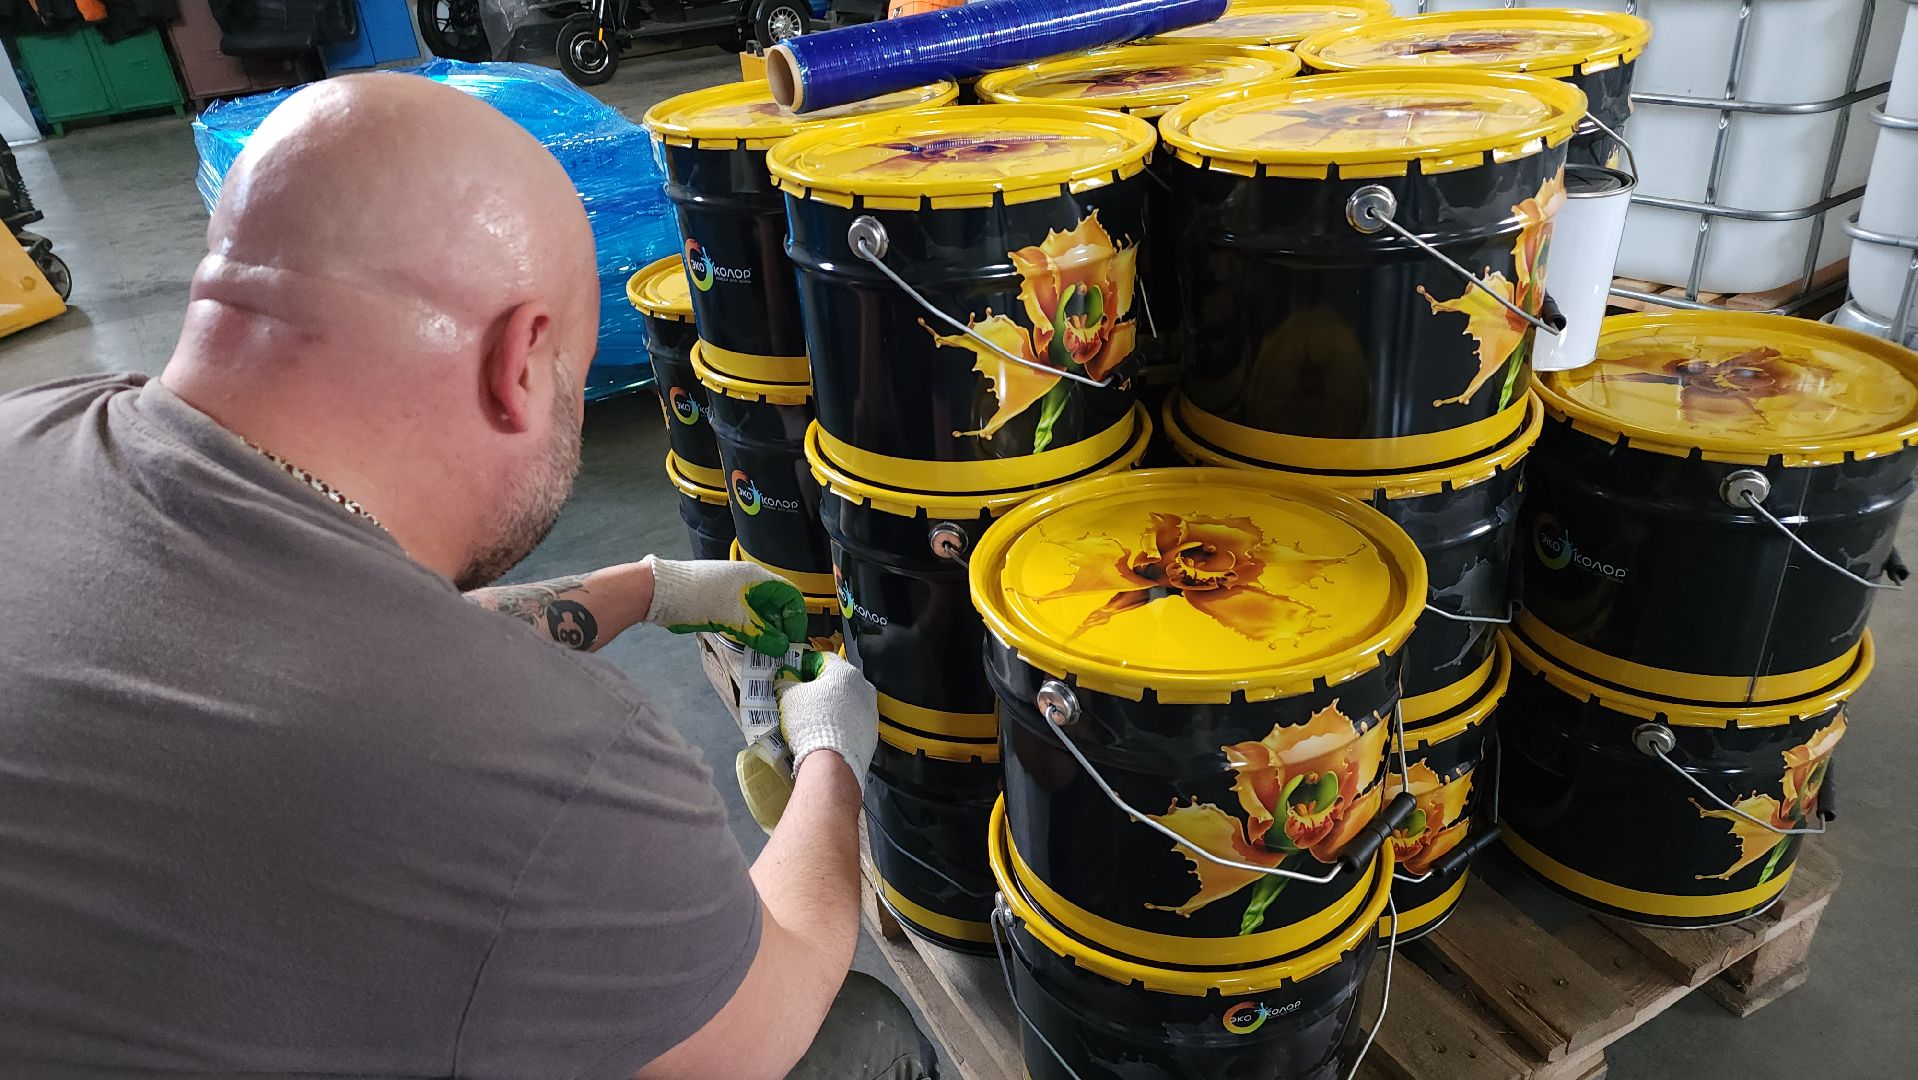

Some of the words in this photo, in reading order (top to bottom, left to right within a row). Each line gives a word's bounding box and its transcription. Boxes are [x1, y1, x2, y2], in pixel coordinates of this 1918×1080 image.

[690, 259, 705, 273] ЭКО
[713, 265, 752, 280] КОЛОР
[738, 486, 753, 501] ЭКО
[761, 495, 799, 509] КОЛОР
[1574, 551, 1626, 578] КОЛОР
[852, 602, 888, 626] КОЛОР
[1230, 1014, 1252, 1023] ЭКО
[1265, 1000, 1302, 1017] КОЛОР
